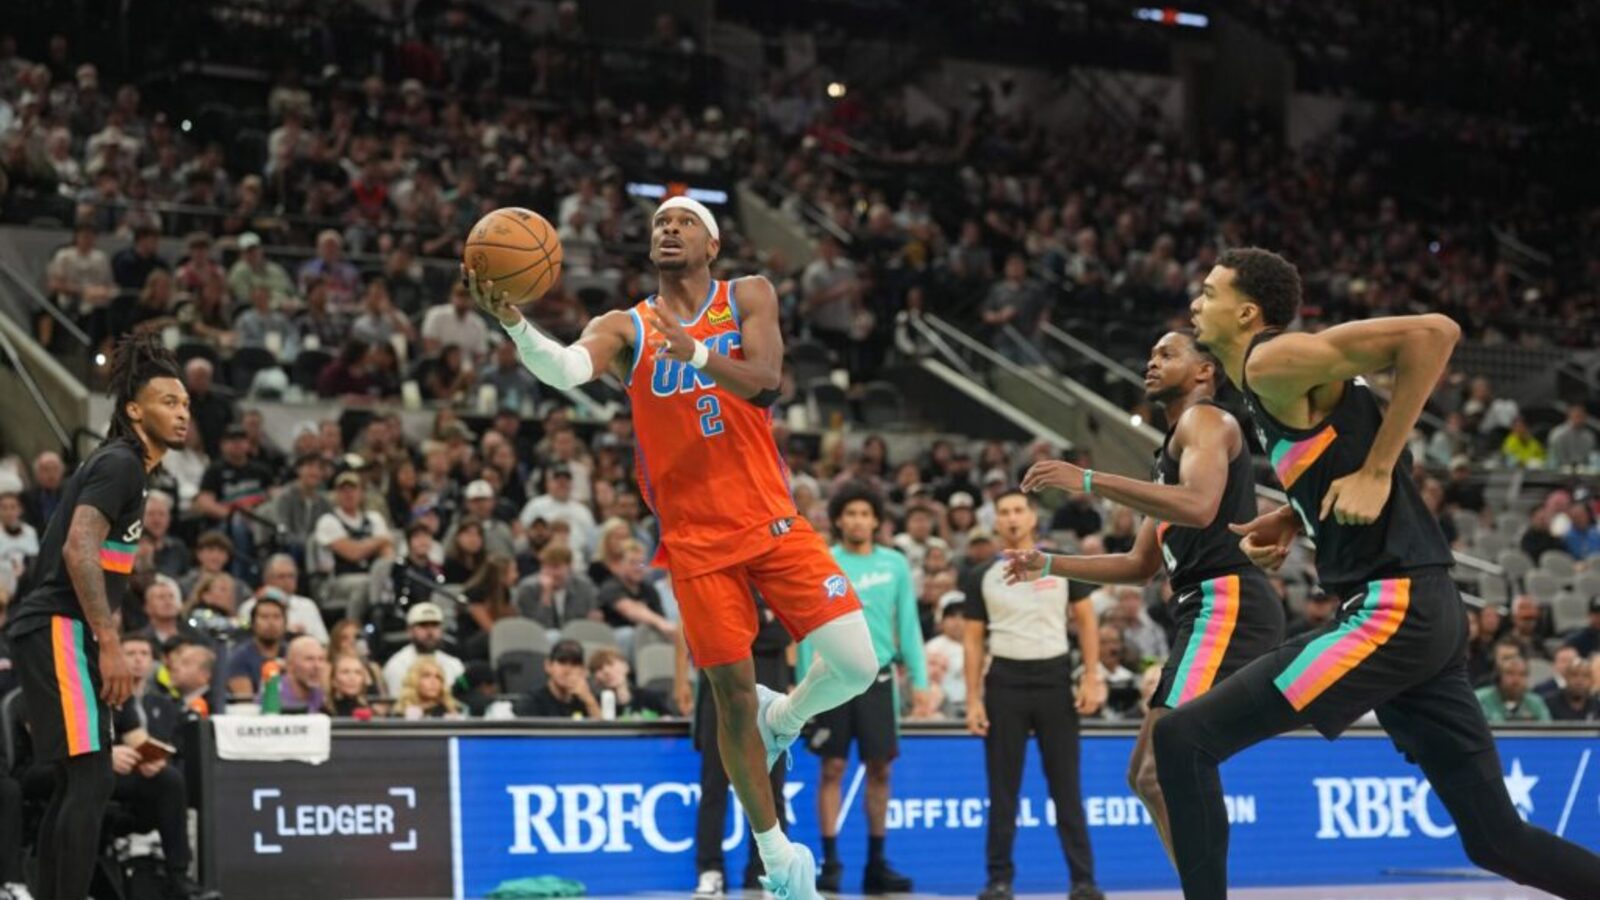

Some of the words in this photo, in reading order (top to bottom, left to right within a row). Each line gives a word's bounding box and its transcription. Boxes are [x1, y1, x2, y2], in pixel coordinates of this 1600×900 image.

[697, 394, 724, 437] 2
[277, 804, 395, 836] LEDGER
[885, 798, 1040, 828] OFFICL
